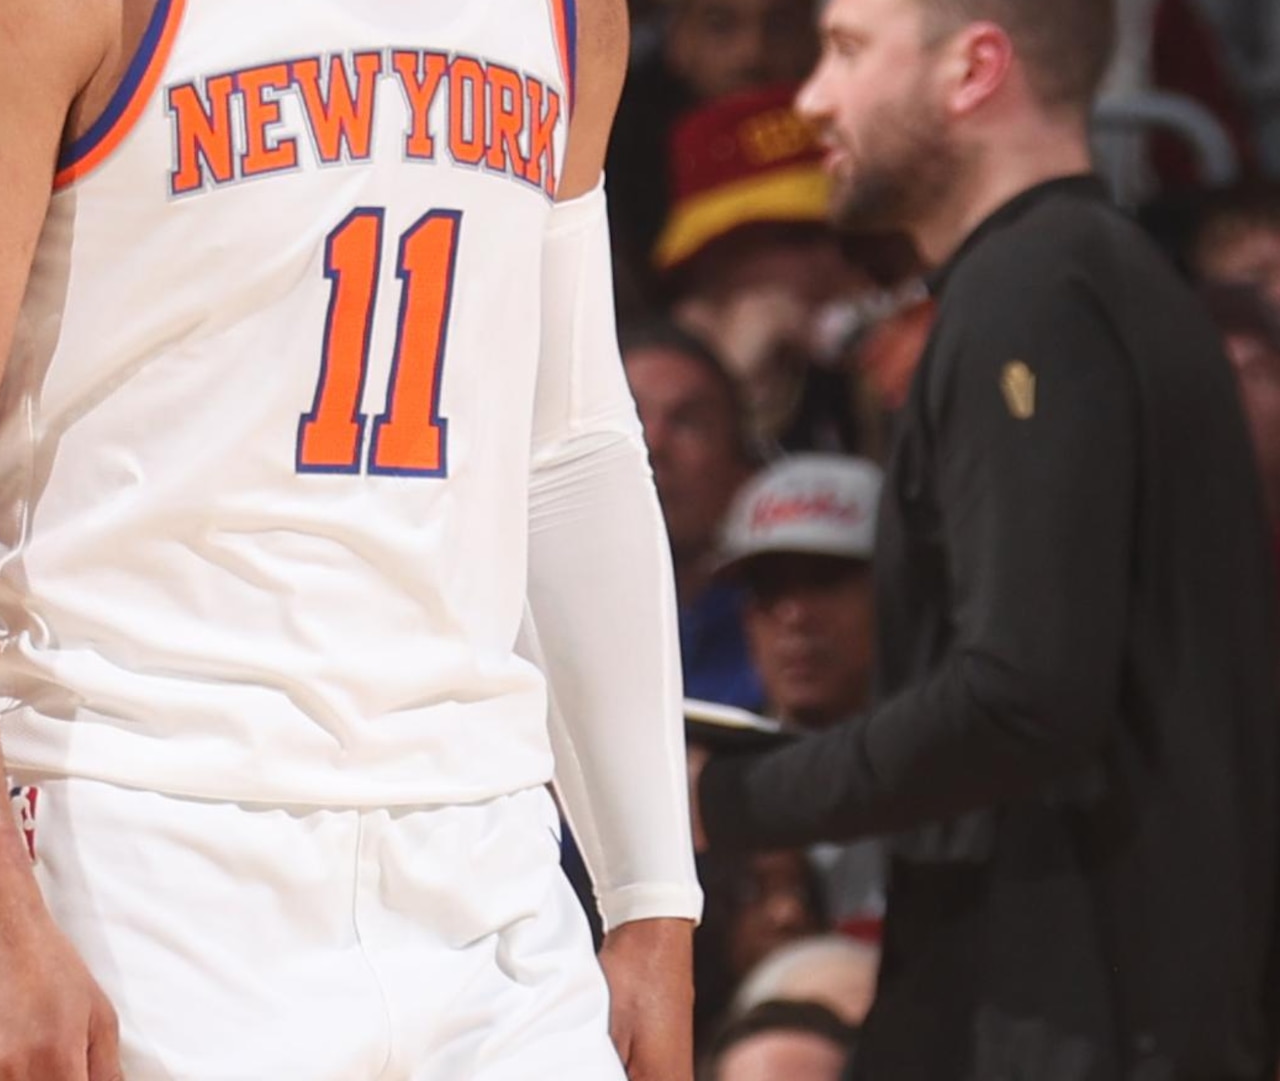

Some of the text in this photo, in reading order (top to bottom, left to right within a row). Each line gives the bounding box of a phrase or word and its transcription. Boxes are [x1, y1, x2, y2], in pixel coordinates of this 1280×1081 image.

[166, 47, 561, 206] NEW YORK
[295, 206, 464, 479] 11
